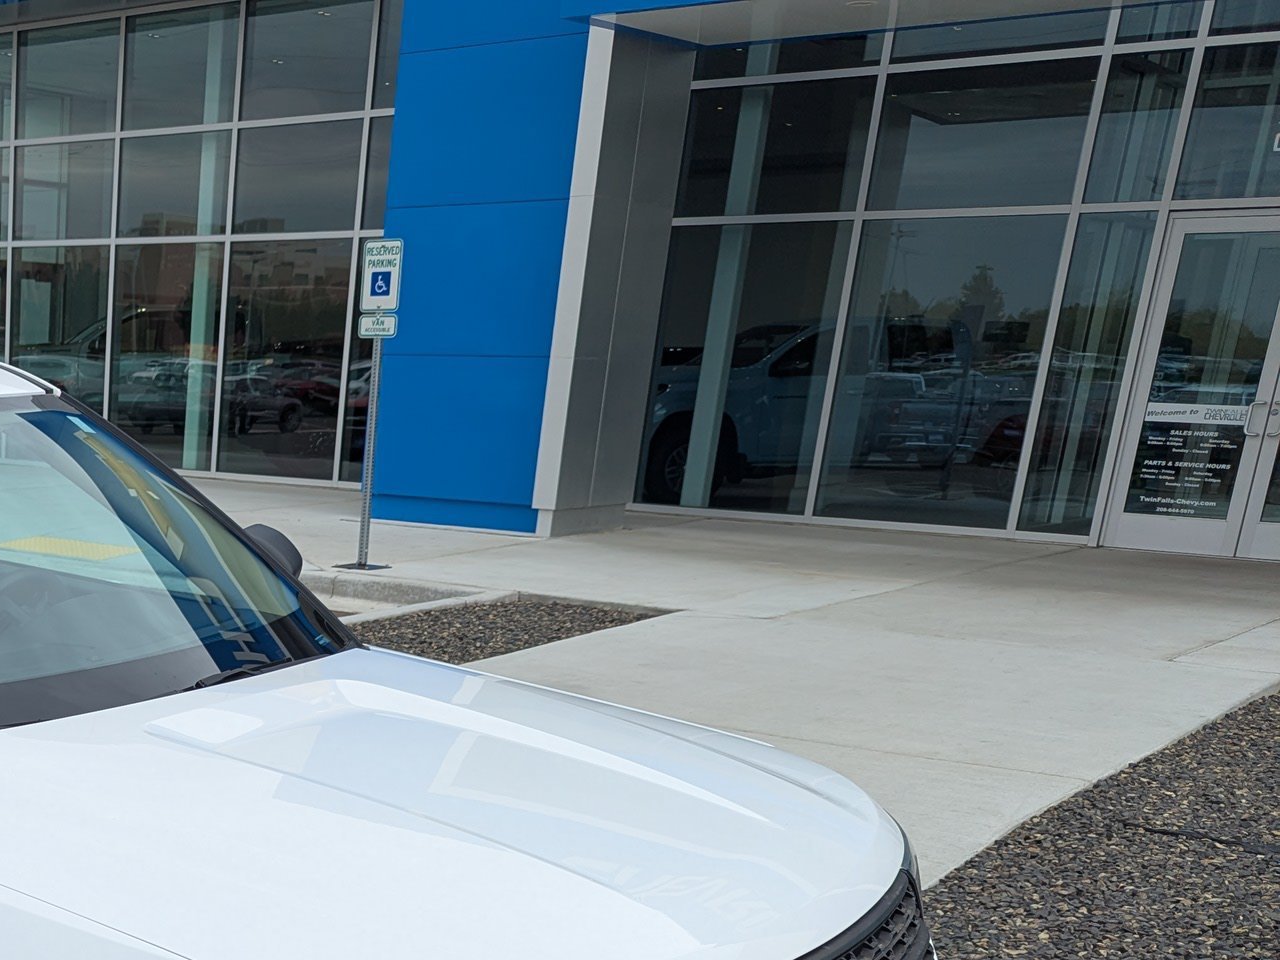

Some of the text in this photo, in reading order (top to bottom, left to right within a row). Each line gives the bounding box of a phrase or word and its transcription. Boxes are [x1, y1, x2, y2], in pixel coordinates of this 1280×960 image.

[367, 246, 400, 257] RESERVED
[368, 258, 397, 268] PARKING
[1147, 408, 1199, 417] Welcome to
[1140, 496, 1216, 506] TwinFalls-Chevy.com
